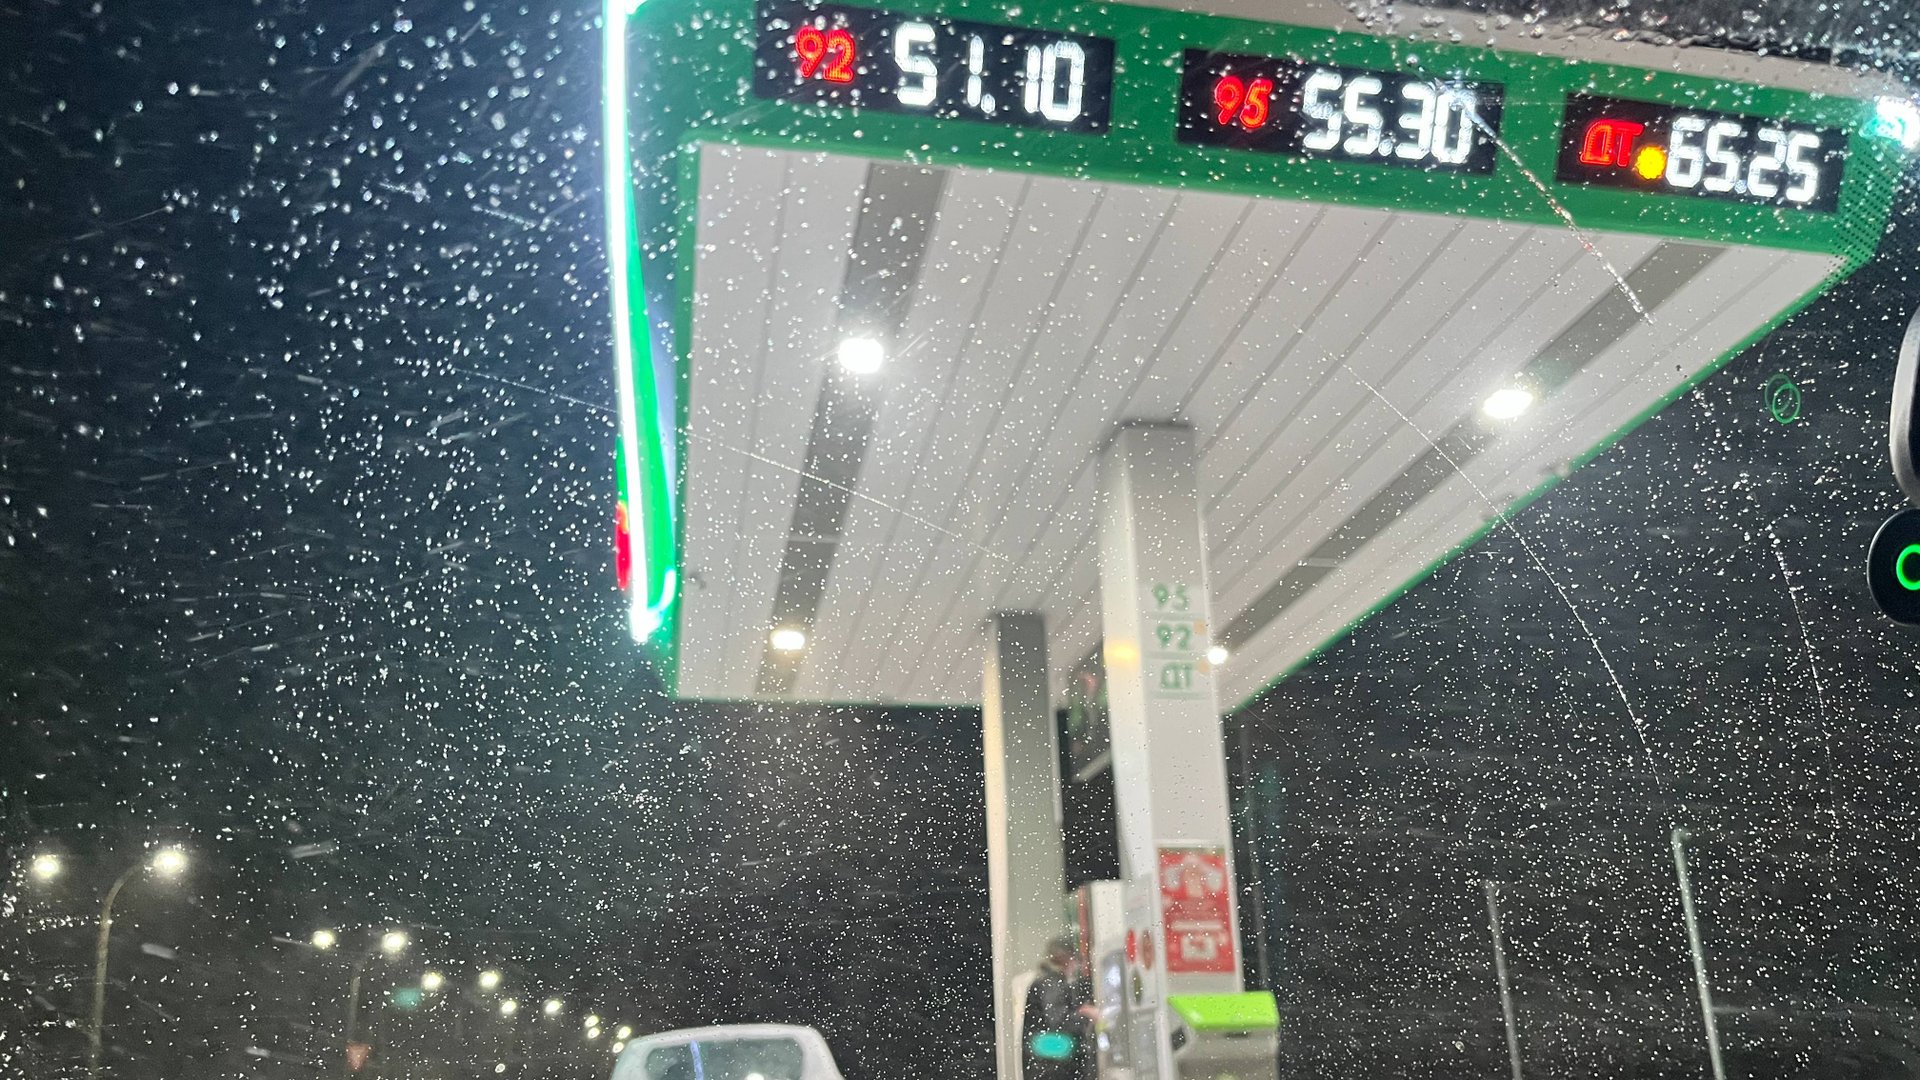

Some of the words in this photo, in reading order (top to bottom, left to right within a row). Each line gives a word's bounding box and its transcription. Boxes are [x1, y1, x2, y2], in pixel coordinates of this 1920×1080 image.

[795, 25, 856, 83] 92
[894, 21, 1086, 122] 51.10
[1214, 75, 1274, 129] 95
[1302, 71, 1477, 164] 55.30
[1580, 118, 1645, 167] ДТ
[1665, 116, 1821, 202] 65.25
[1153, 583, 1190, 611] 95
[1156, 624, 1192, 649] 92
